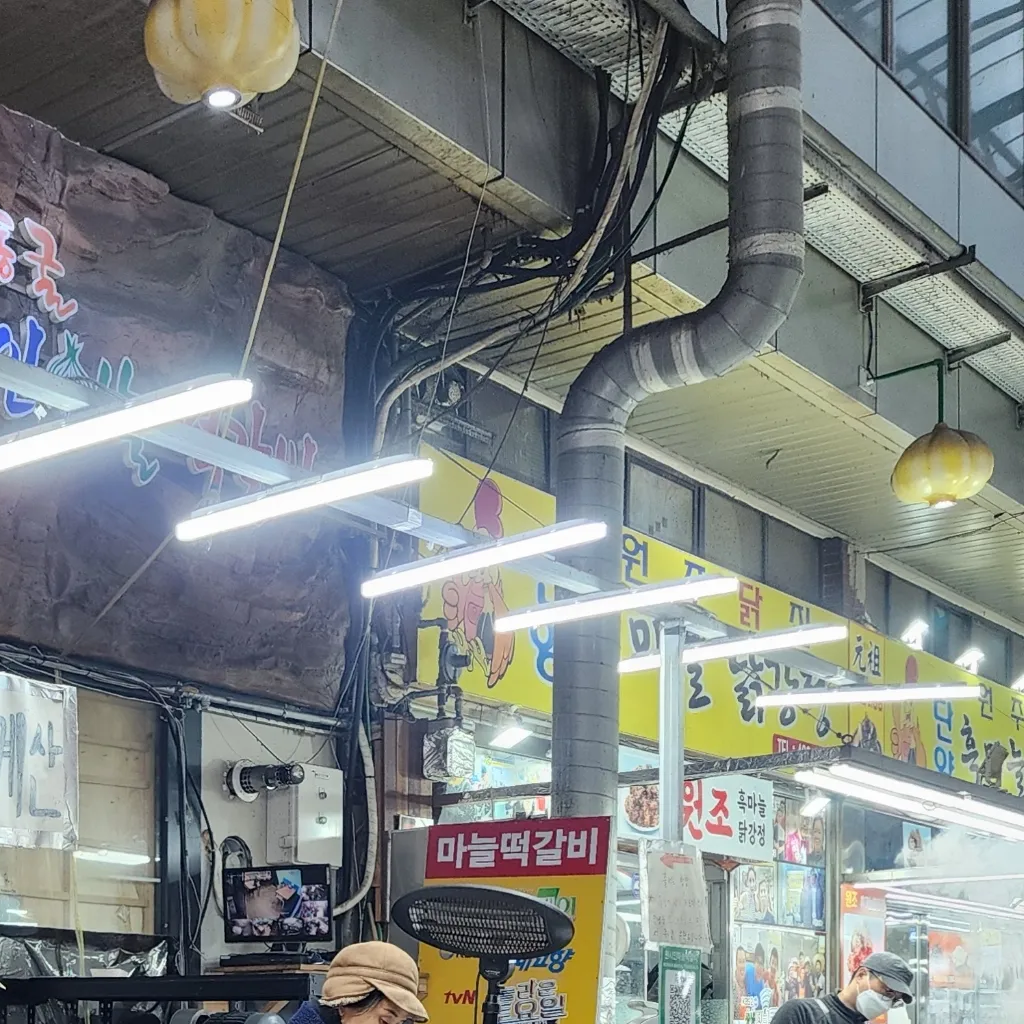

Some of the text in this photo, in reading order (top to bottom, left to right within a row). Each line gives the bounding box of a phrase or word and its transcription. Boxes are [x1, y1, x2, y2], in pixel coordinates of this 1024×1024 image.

[852, 634, 882, 678] 元祖
[683, 779, 733, 840] 원조
[738, 789, 766, 818] 흑마늘
[437, 827, 597, 869] 마늘떡갈비
[739, 820, 765, 846] 닭강정
[444, 990, 476, 1004] tvN
